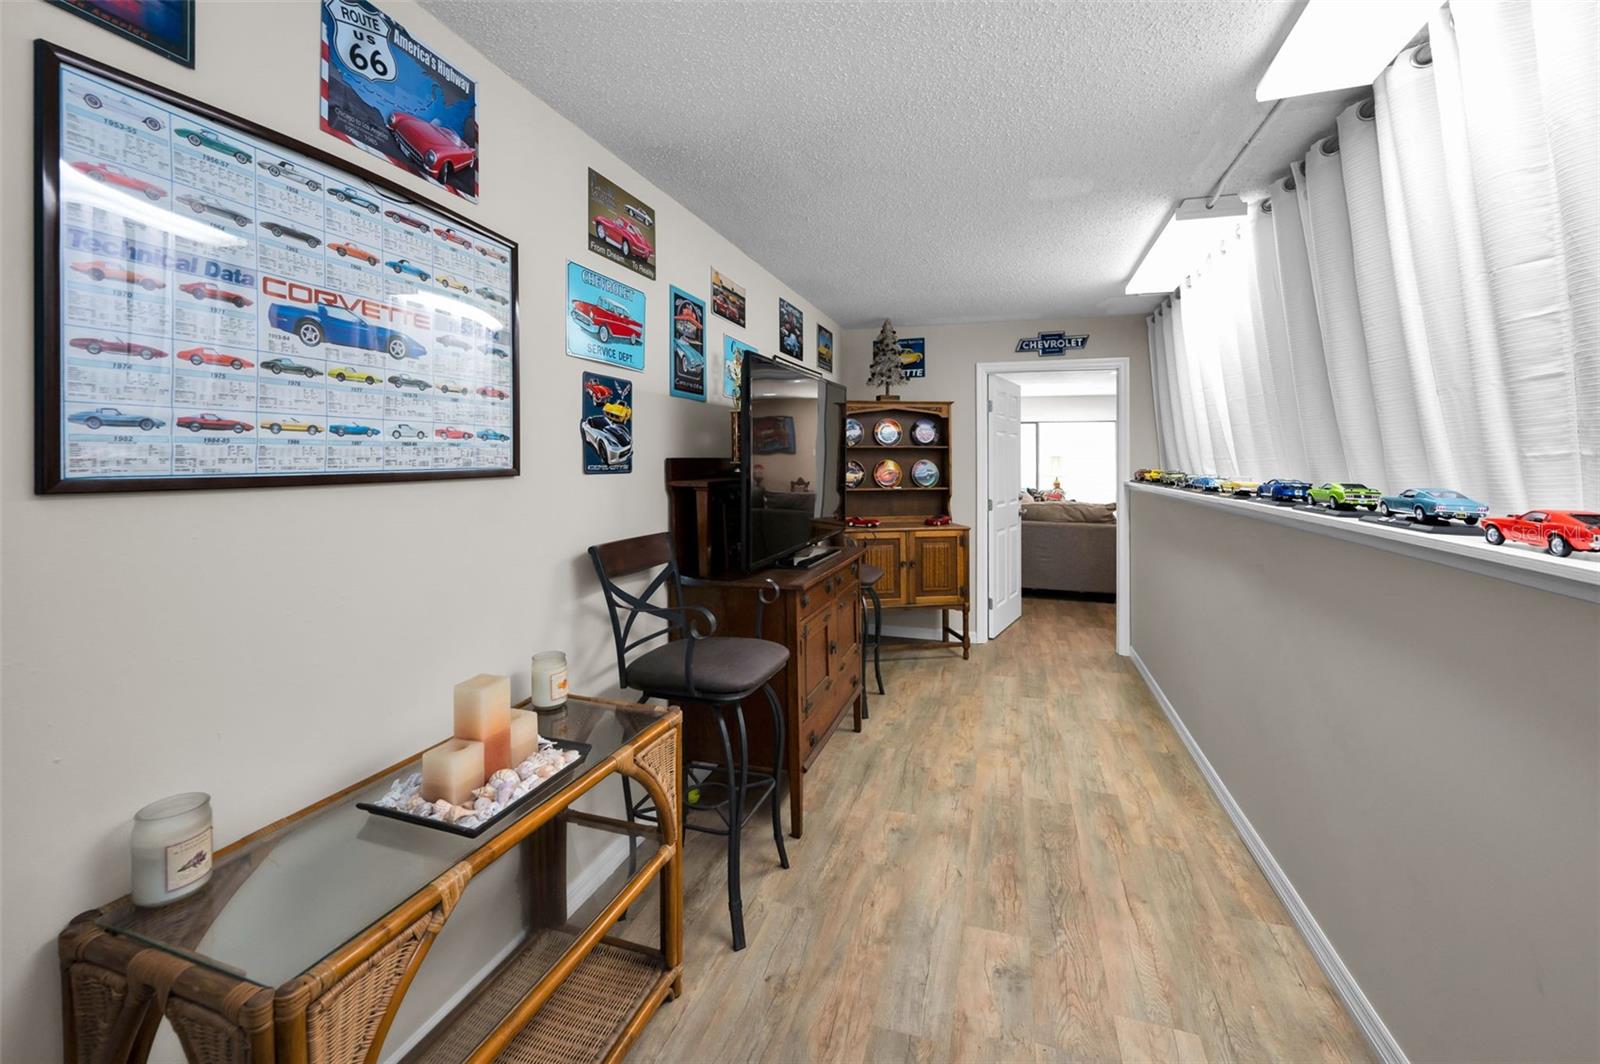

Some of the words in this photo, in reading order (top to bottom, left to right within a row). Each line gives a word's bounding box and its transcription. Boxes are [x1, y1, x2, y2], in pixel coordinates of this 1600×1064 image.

[341, 6, 381, 32] ROUTE
[353, 30, 376, 46] US
[349, 43, 388, 77] 66
[393, 28, 437, 70] America's
[437, 57, 470, 94] Highway
[103, 117, 137, 135] 1953-55
[202, 153, 230, 168] 1956-57
[67, 228, 199, 273] Technical
[204, 260, 255, 287] Data
[590, 240, 606, 255] From
[632, 260, 640, 271] To
[582, 269, 635, 302] CHEVROLET
[262, 276, 432, 331] CORVETTE
[587, 342, 617, 360] SERVICE
[1022, 338, 1083, 349] CHEVROLET
